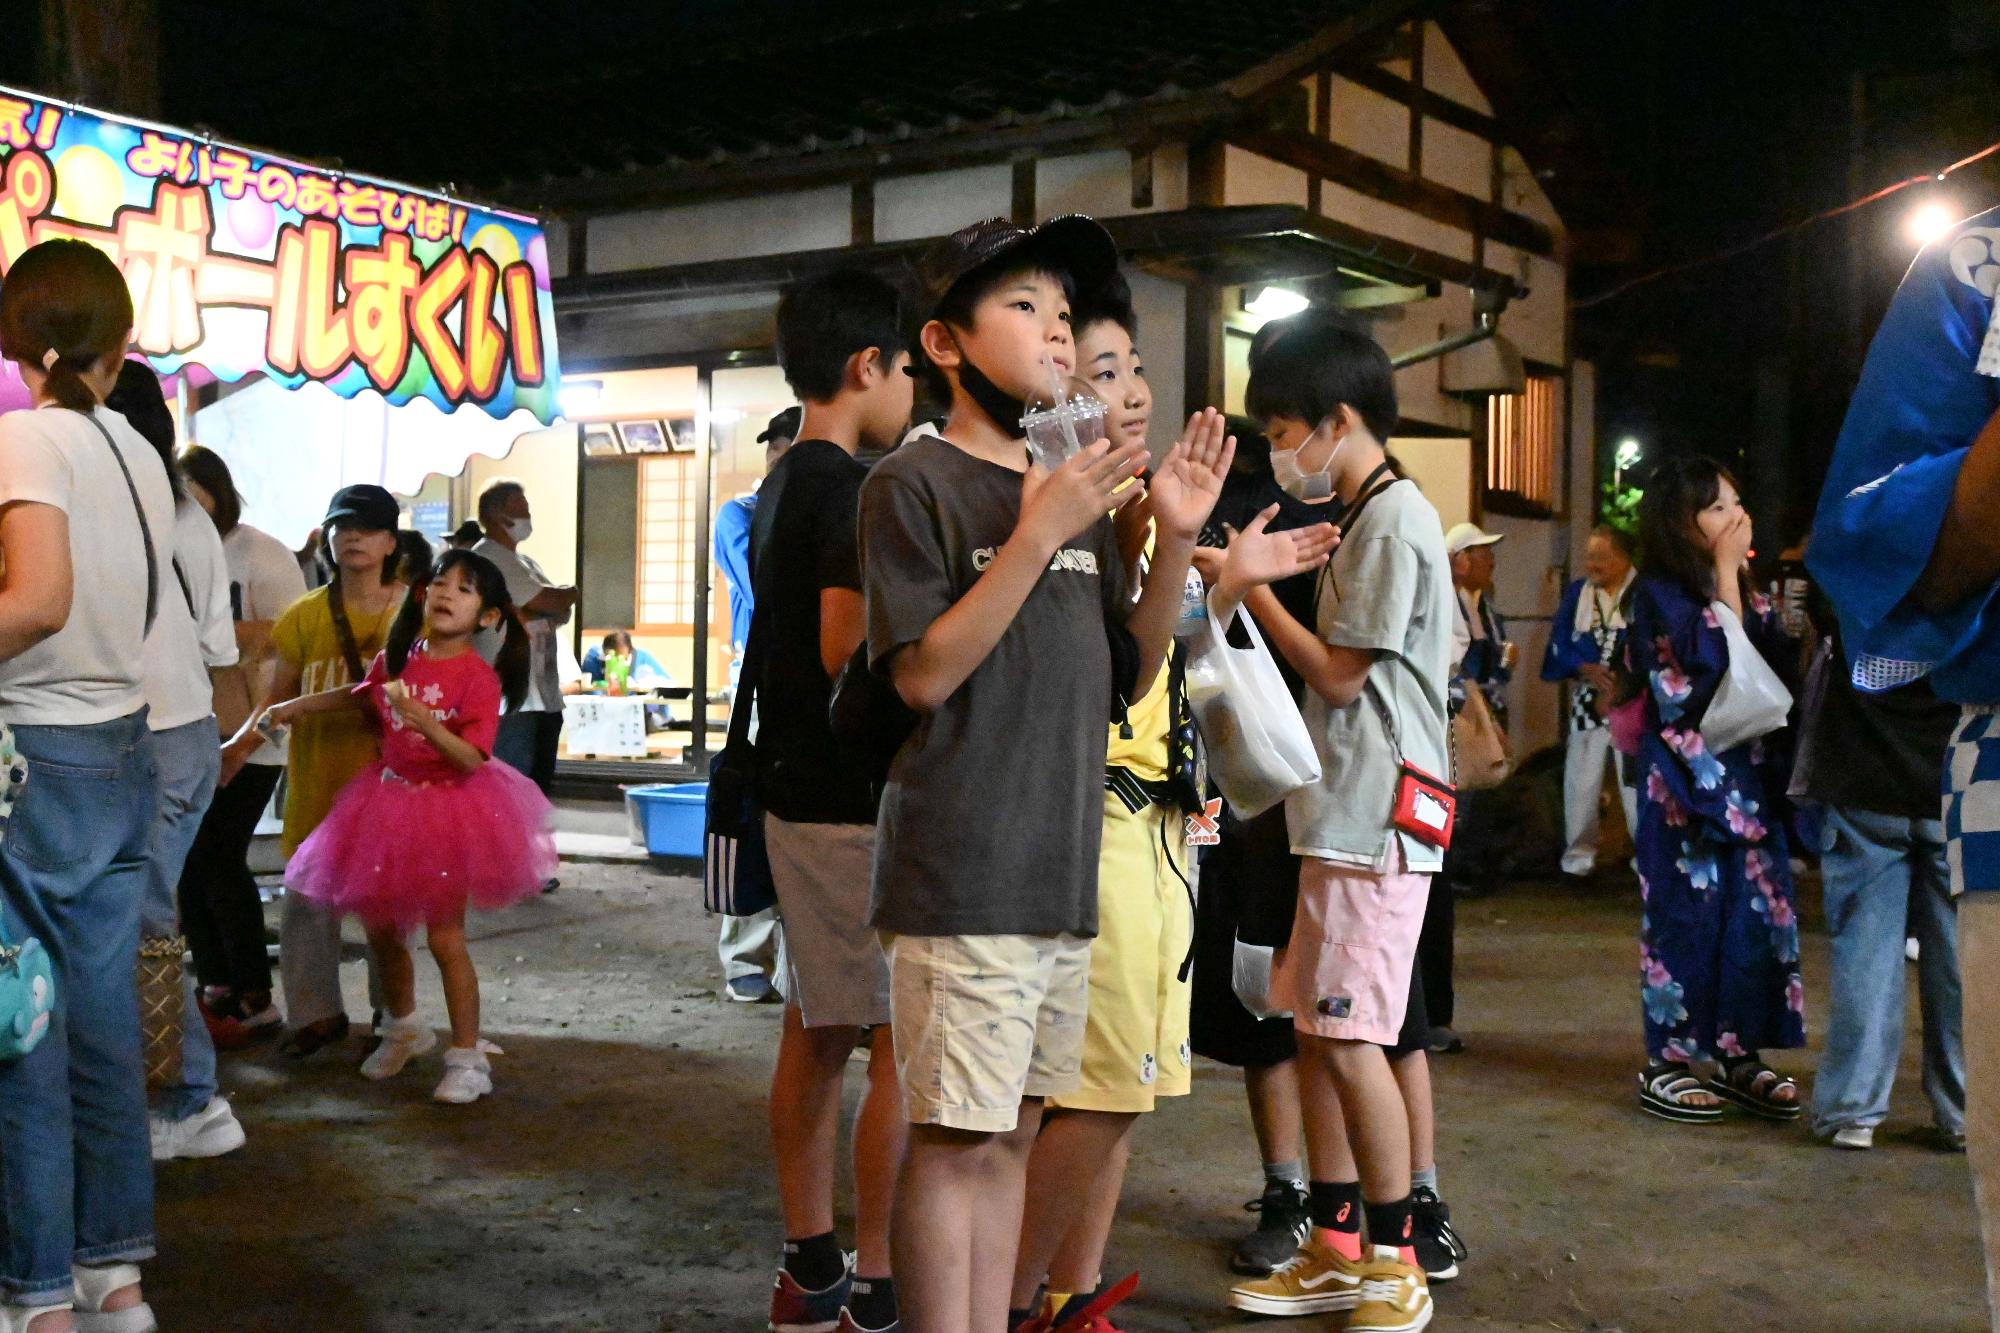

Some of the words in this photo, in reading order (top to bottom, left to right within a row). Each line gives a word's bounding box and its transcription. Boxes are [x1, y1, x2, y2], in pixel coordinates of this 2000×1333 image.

[127, 132, 468, 243] よい子のあそびば!
